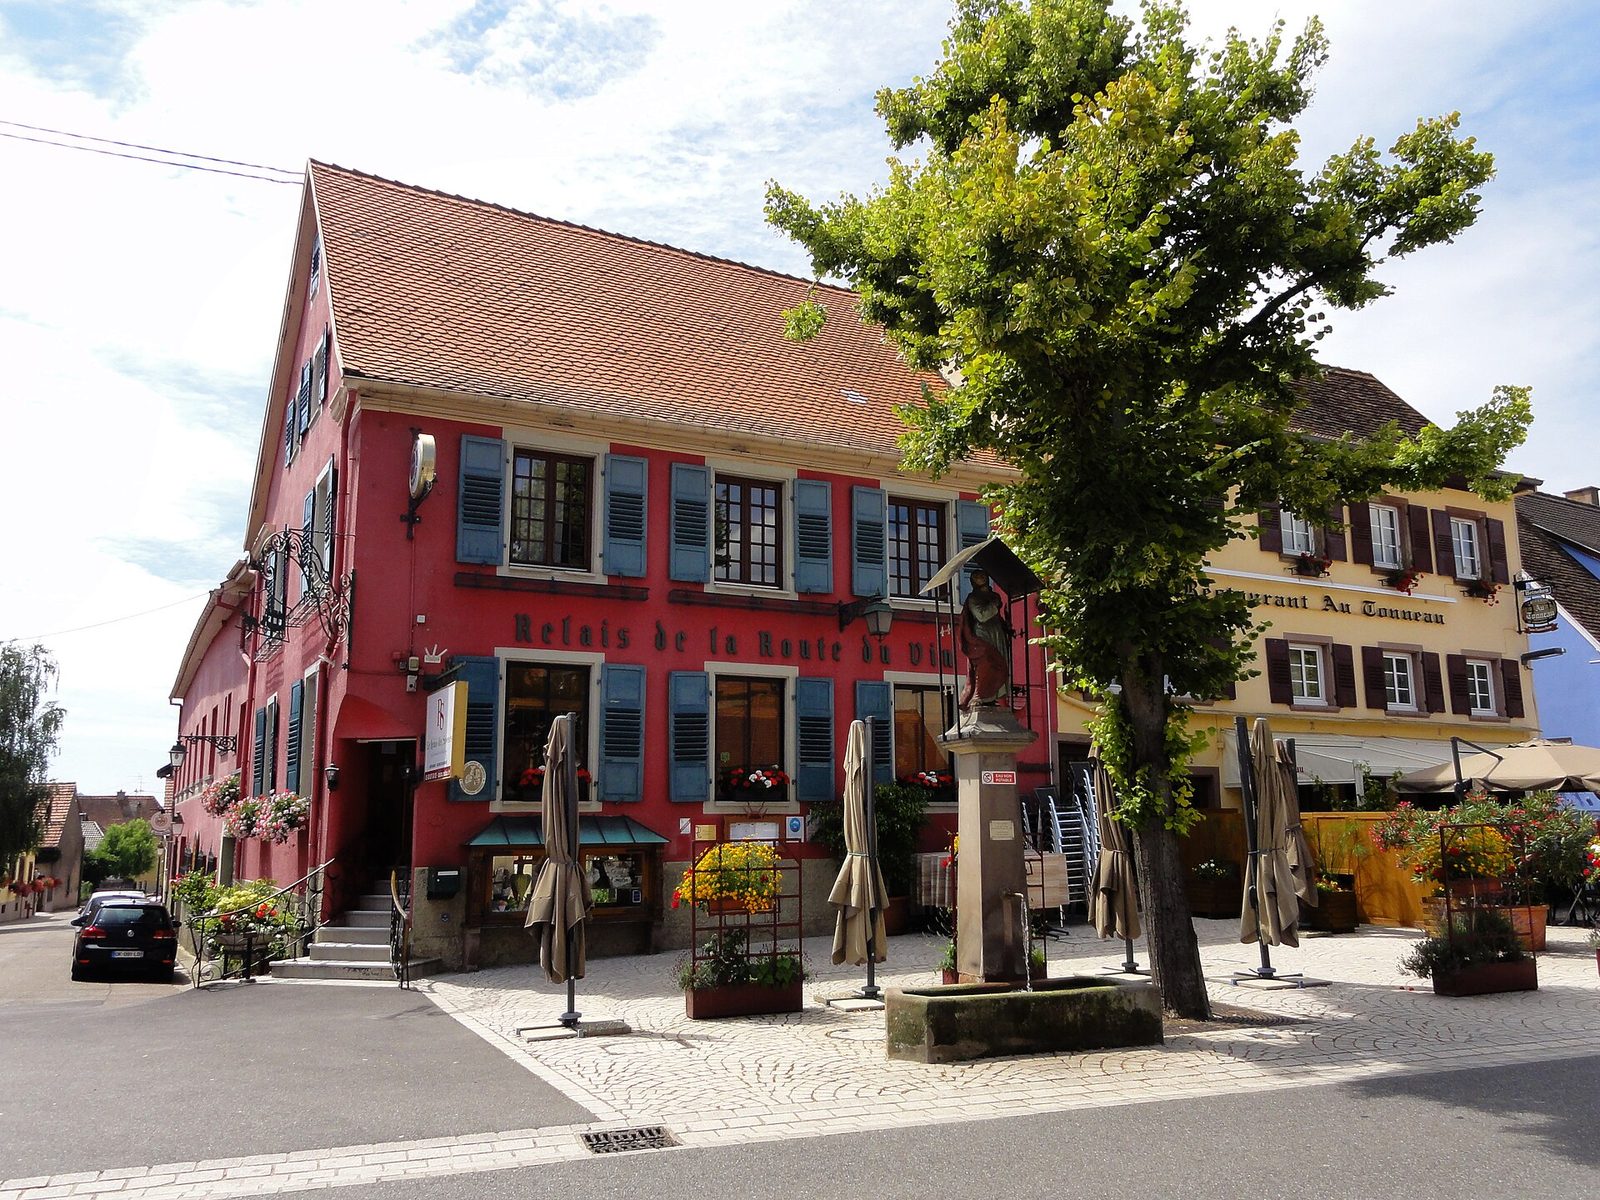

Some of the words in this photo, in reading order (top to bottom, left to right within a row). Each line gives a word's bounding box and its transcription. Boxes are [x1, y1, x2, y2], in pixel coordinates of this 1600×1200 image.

[1322, 595, 1352, 615] Au
[1362, 600, 1446, 625] Tonneau
[513, 612, 631, 649] Relais
[654, 619, 686, 652] de
[710, 626, 737, 655] la
[758, 629, 842, 662] Route
[862, 634, 891, 665] du
[908, 640, 953, 668] Vin
